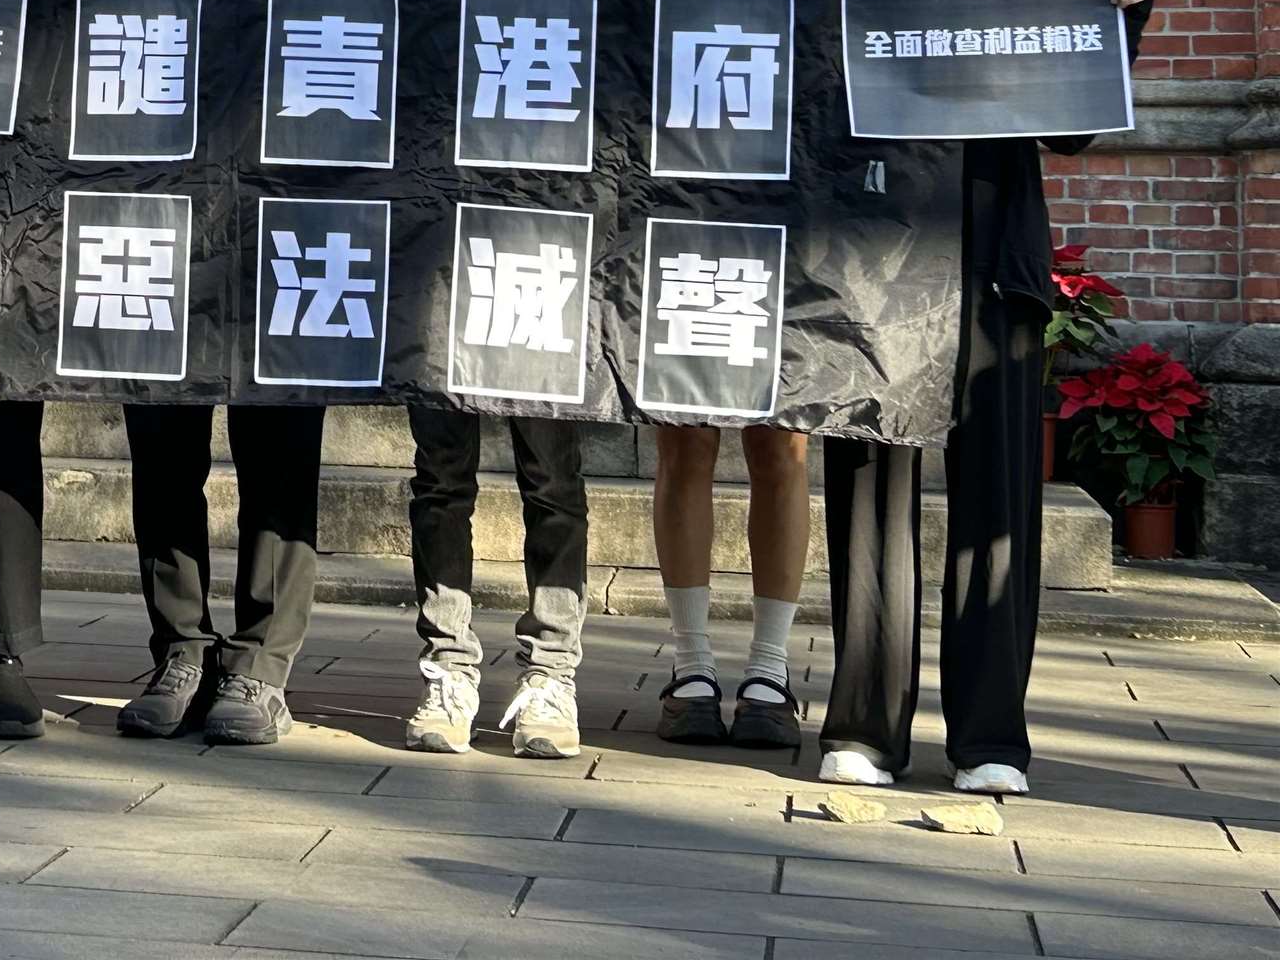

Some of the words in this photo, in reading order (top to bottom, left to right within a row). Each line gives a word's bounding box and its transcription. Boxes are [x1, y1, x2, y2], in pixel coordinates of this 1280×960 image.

[865, 24, 1104, 58] 全面徹查利益輸送
